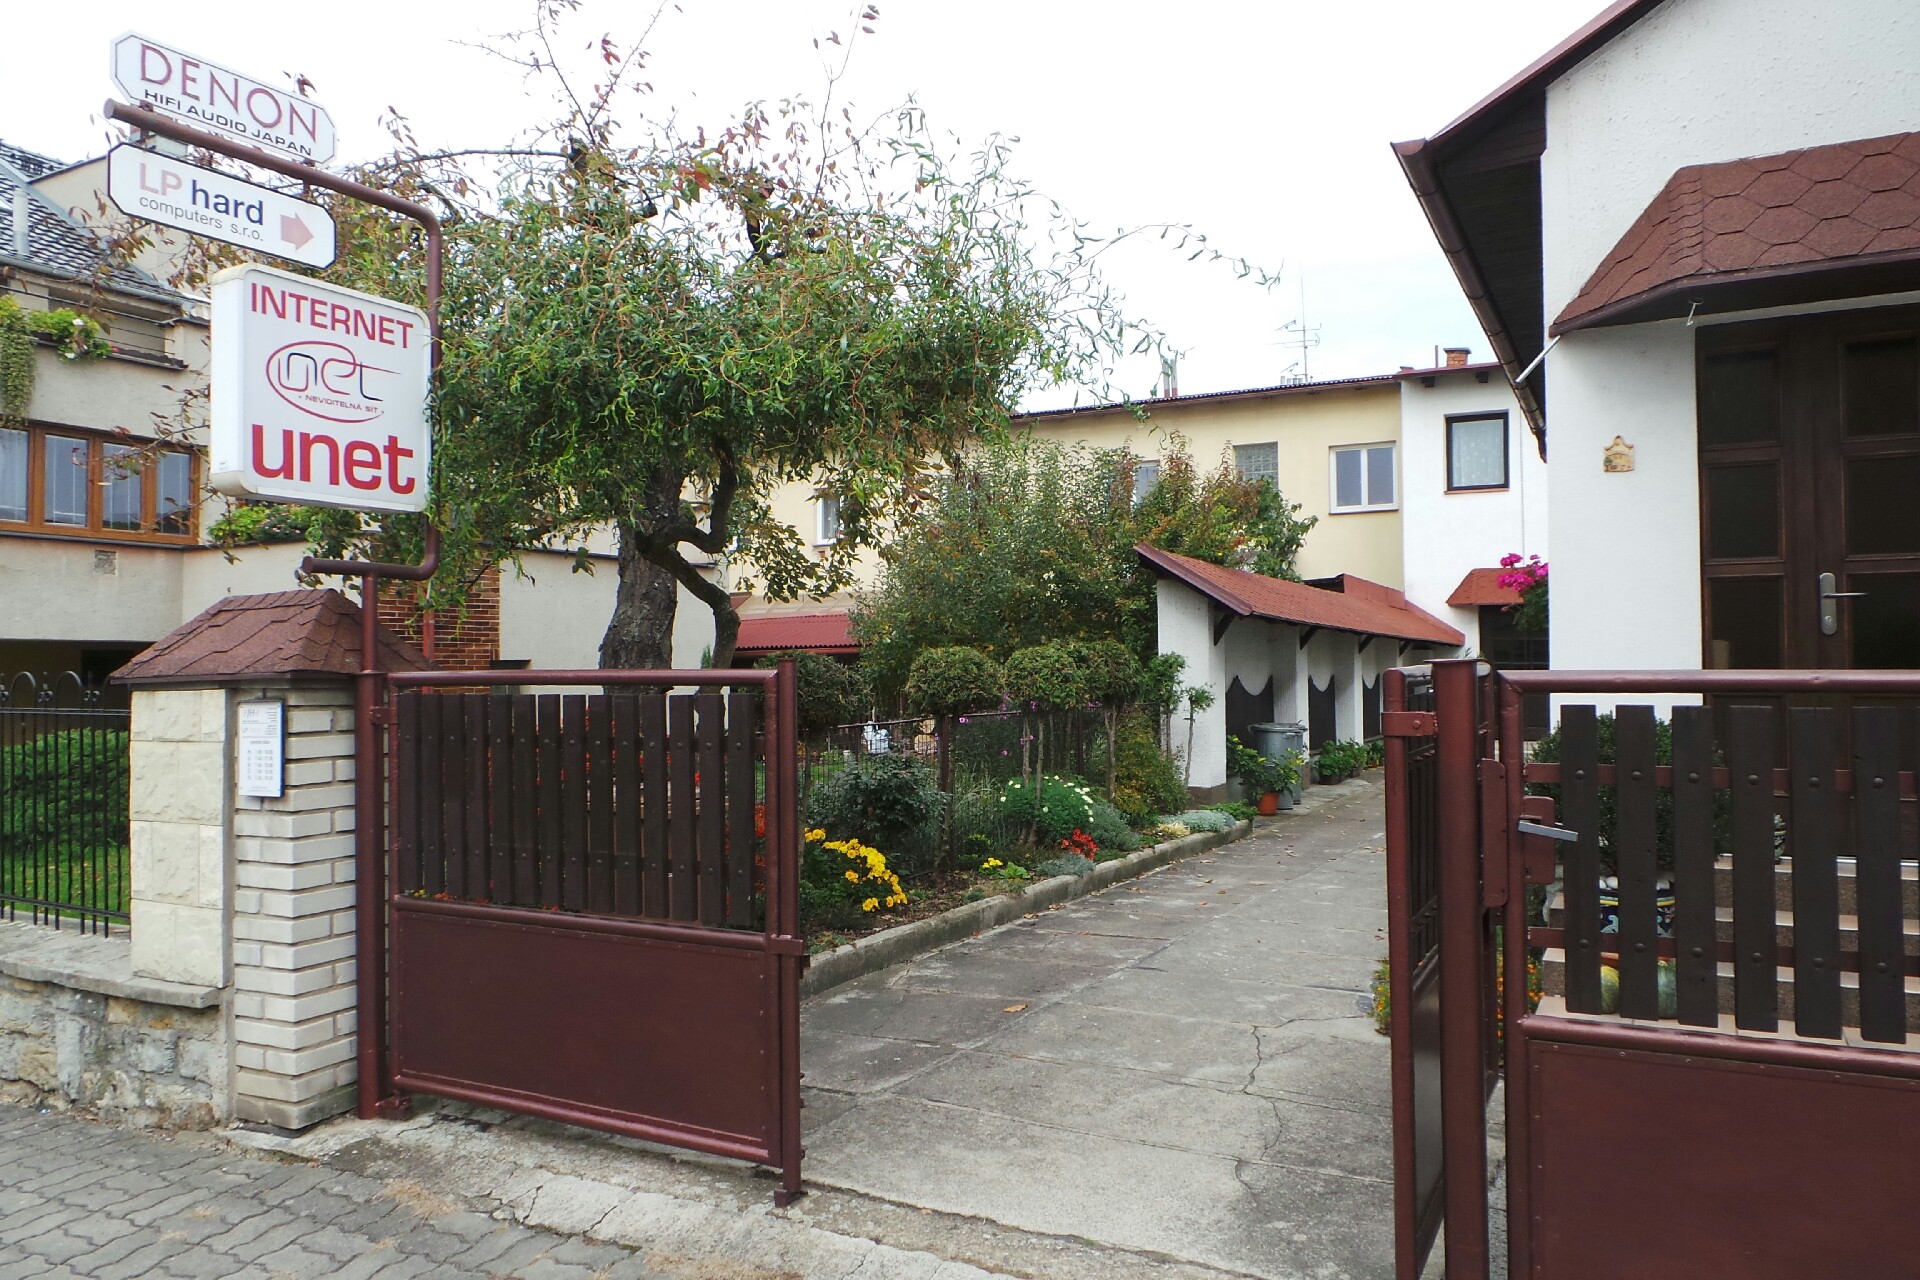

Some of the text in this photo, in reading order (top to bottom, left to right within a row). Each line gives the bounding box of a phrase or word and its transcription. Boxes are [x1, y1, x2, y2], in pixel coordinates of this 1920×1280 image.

[140, 43, 317, 143] DENON
[144, 89, 312, 156] HIFI AUDIO JAPAN
[139, 162, 264, 226] LP hard
[139, 196, 264, 242] computers s.r.o.
[251, 282, 414, 349] INTERNET
[305, 394, 362, 411] NEVIDITELNÁ
[252, 423, 416, 495] unet
